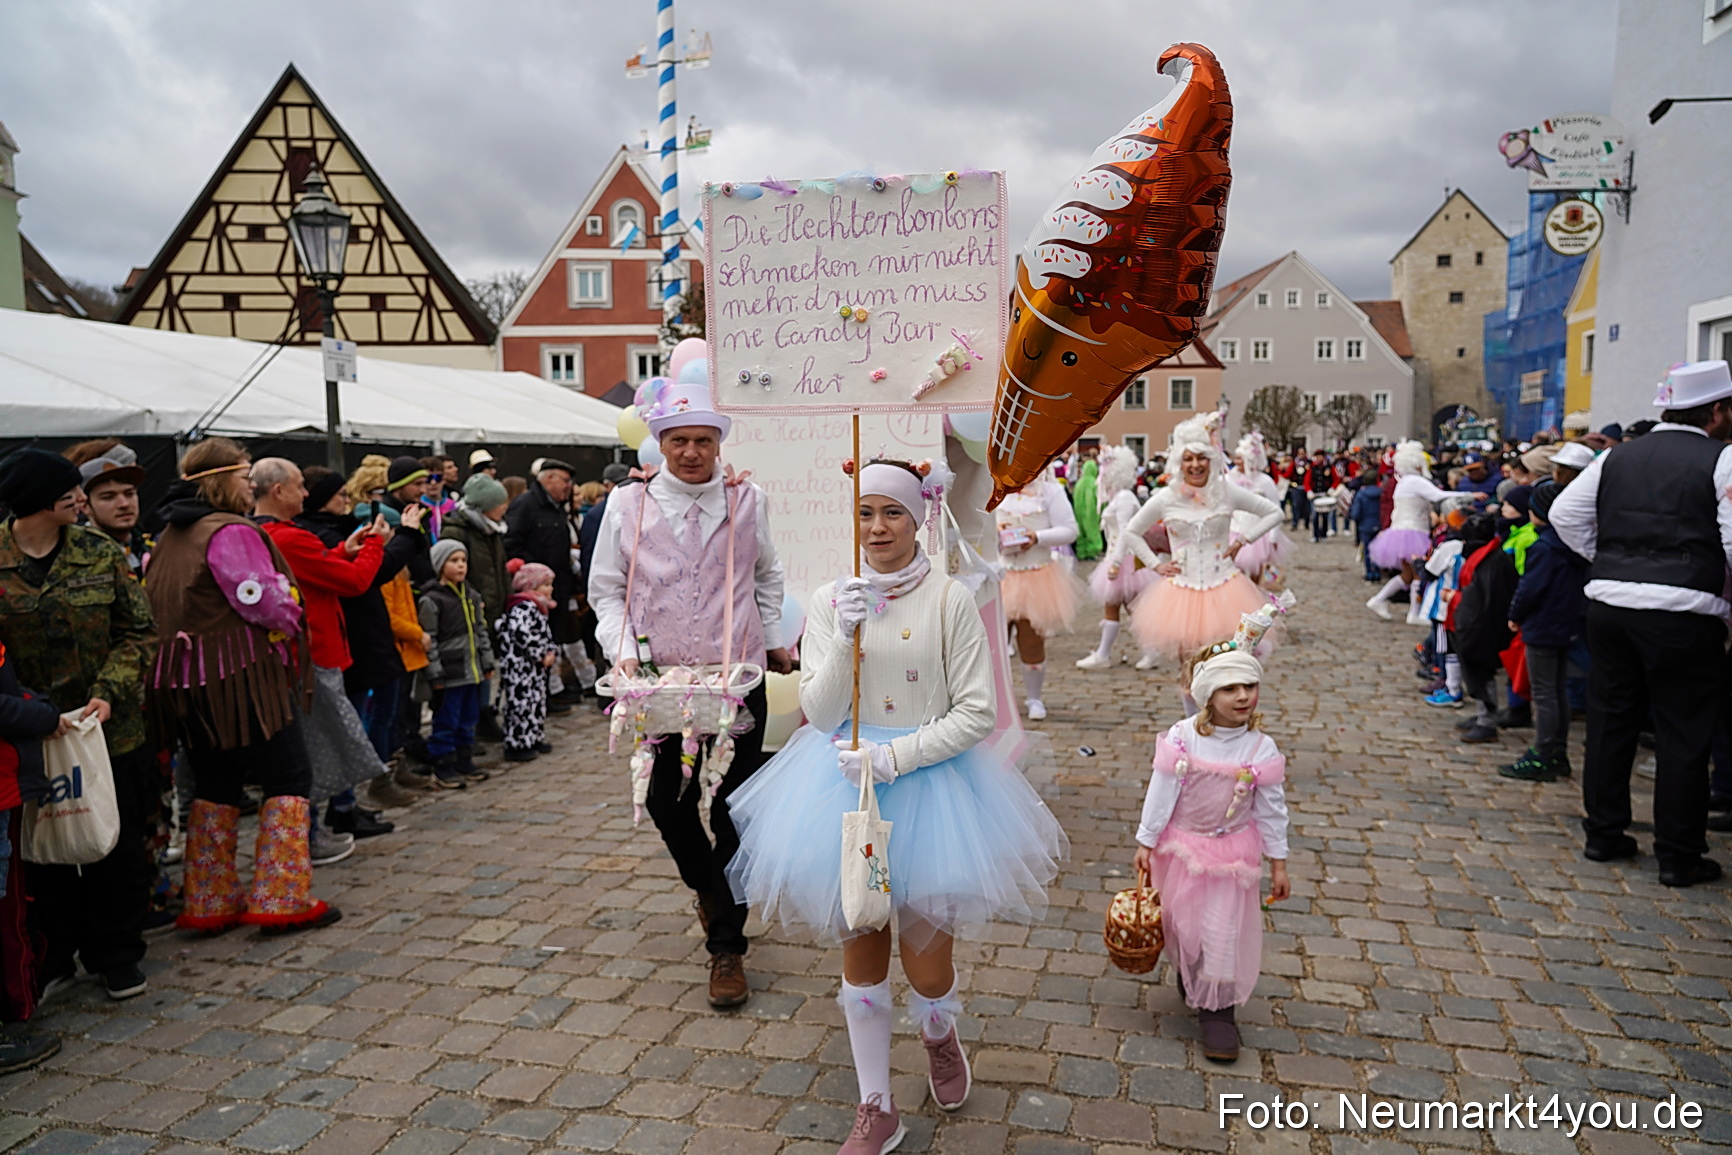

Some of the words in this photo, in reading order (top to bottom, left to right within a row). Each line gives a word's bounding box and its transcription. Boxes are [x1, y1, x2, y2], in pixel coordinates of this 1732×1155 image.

[720, 214, 772, 252] Die
[719, 245, 860, 287] schmecken
[867, 245, 925, 275] mir
[925, 235, 999, 268] nicht
[804, 282, 899, 311] drum
[904, 281, 988, 303] muss
[723, 327, 765, 352] ne
[775, 317, 872, 364] Candy
[879, 311, 941, 344] Bar
[791, 355, 845, 395] her
